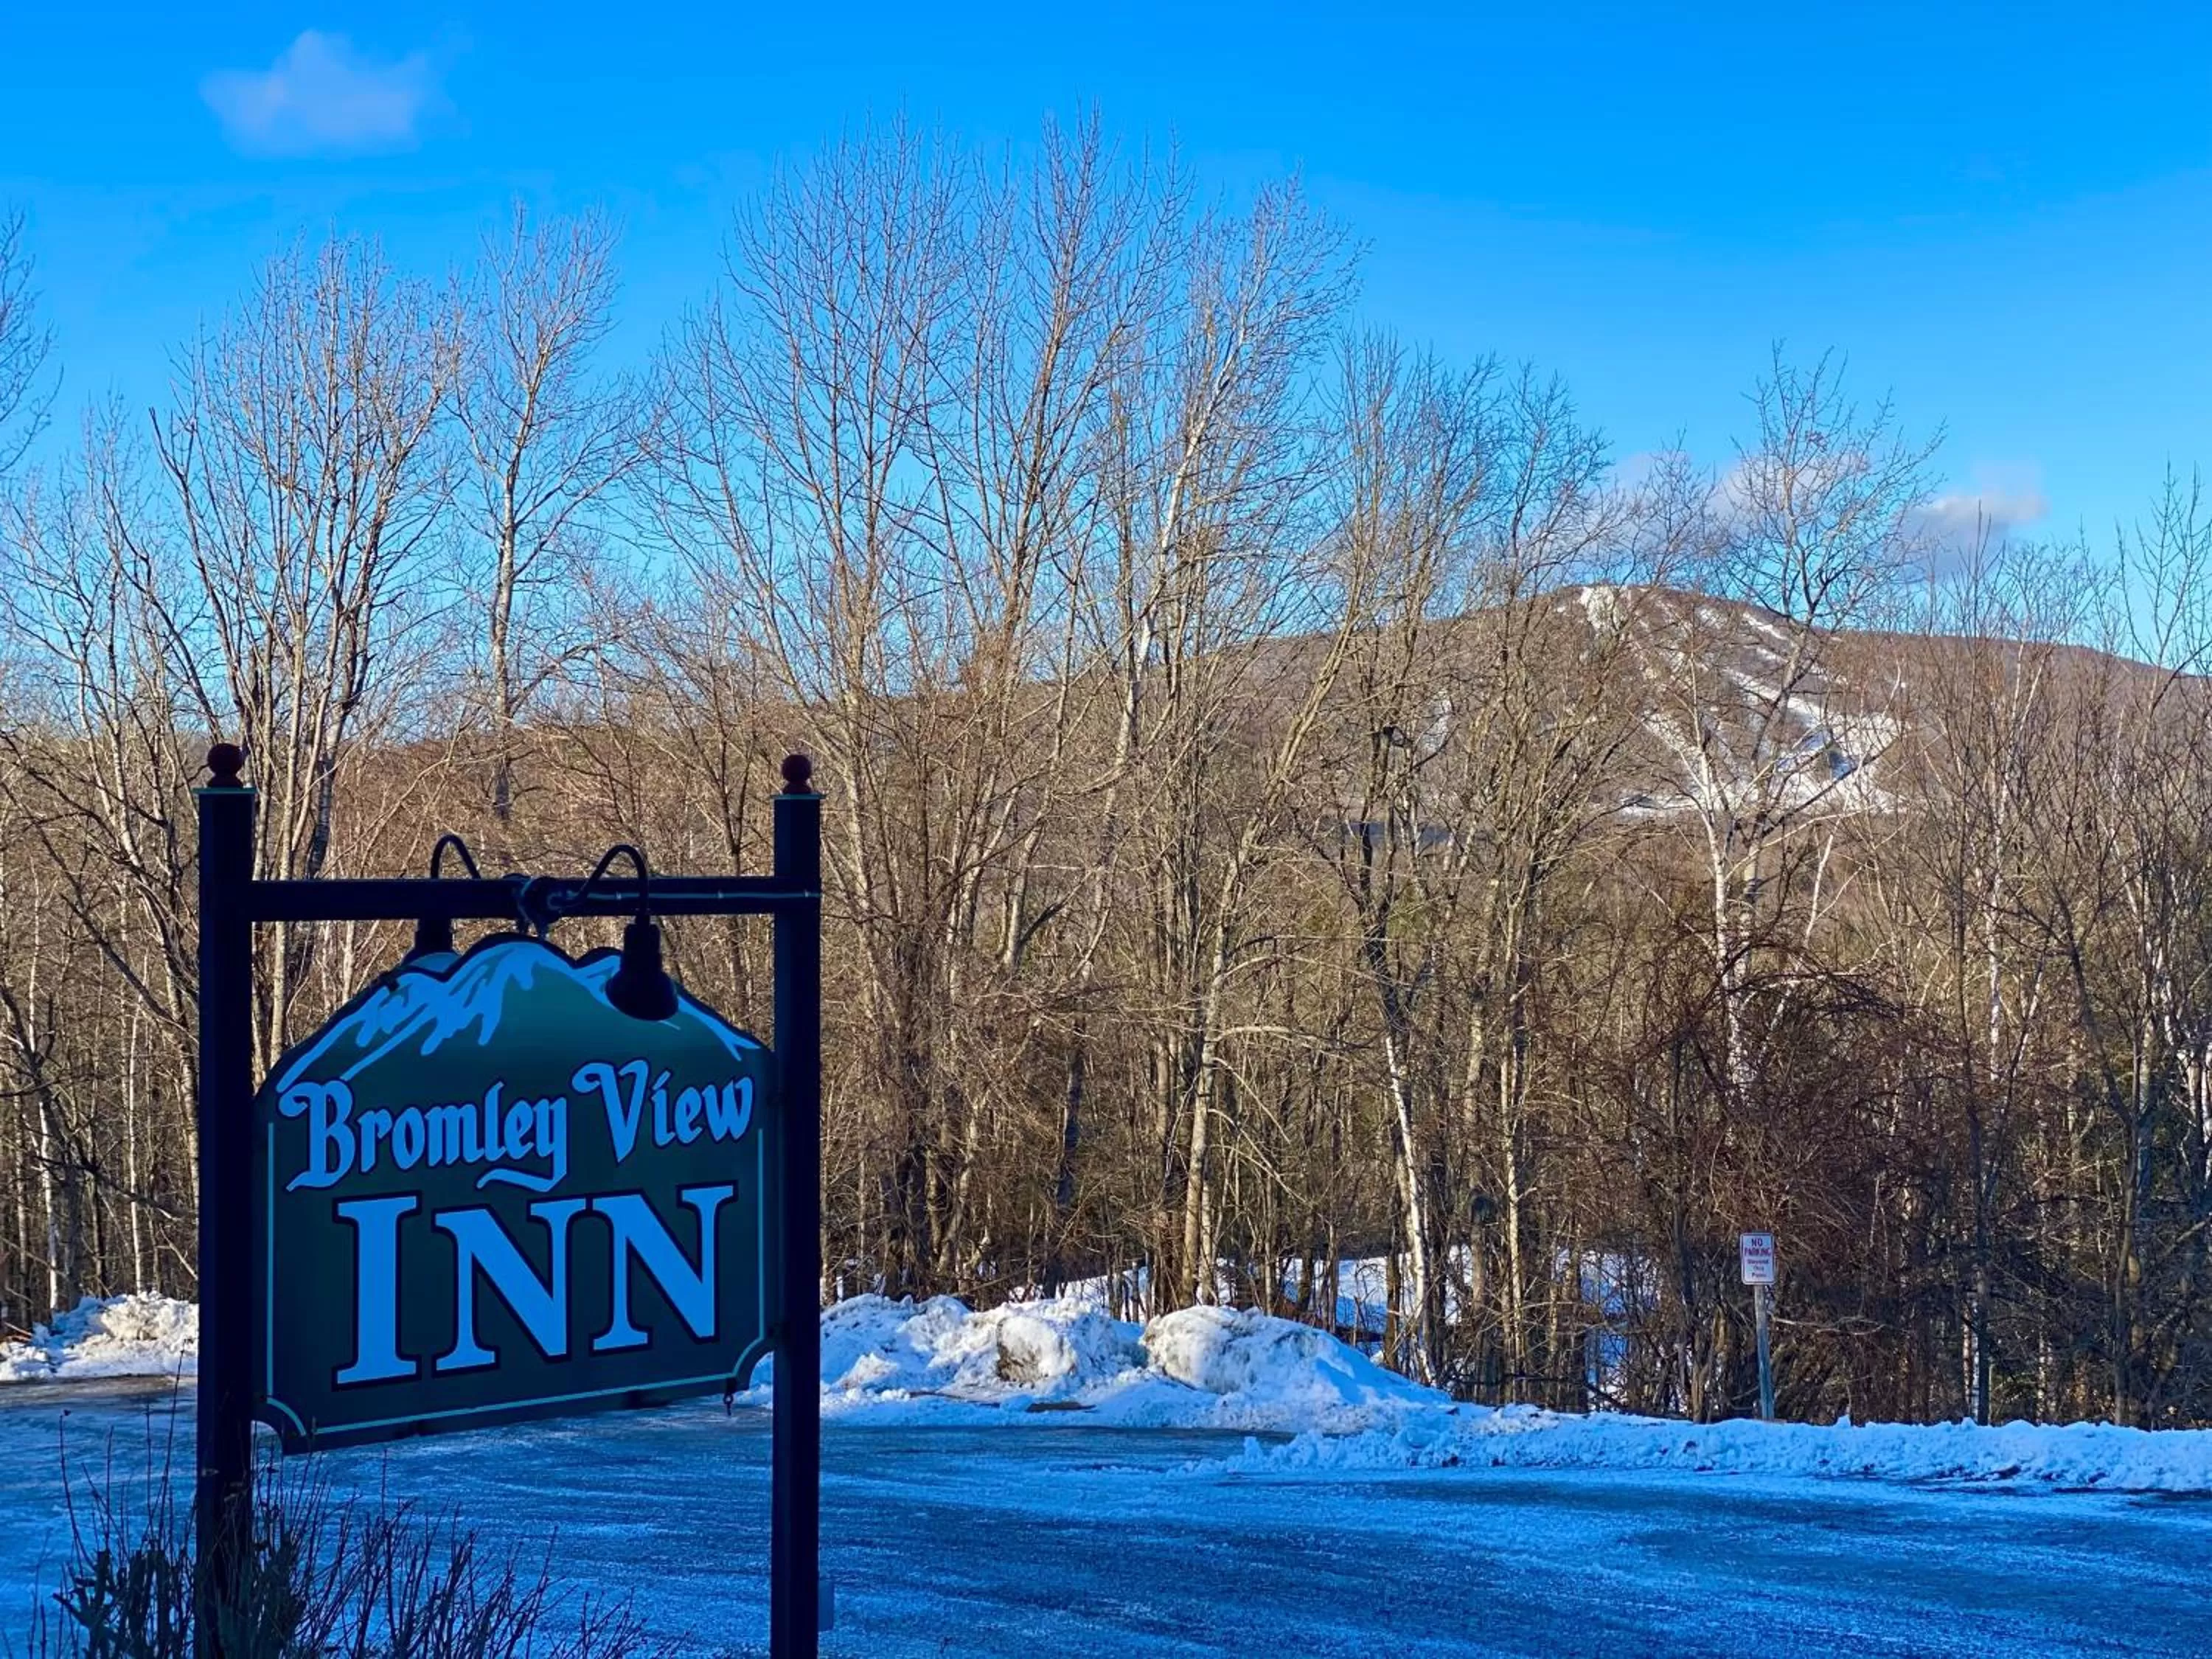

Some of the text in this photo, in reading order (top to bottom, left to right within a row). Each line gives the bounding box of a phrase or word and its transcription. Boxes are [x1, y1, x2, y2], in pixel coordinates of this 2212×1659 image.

[279, 1060, 754, 1192] Bromley View
[1744, 1247, 1772, 1256] PARKING
[1751, 1238, 1763, 1247] NO
[336, 1185, 734, 1385] INN
